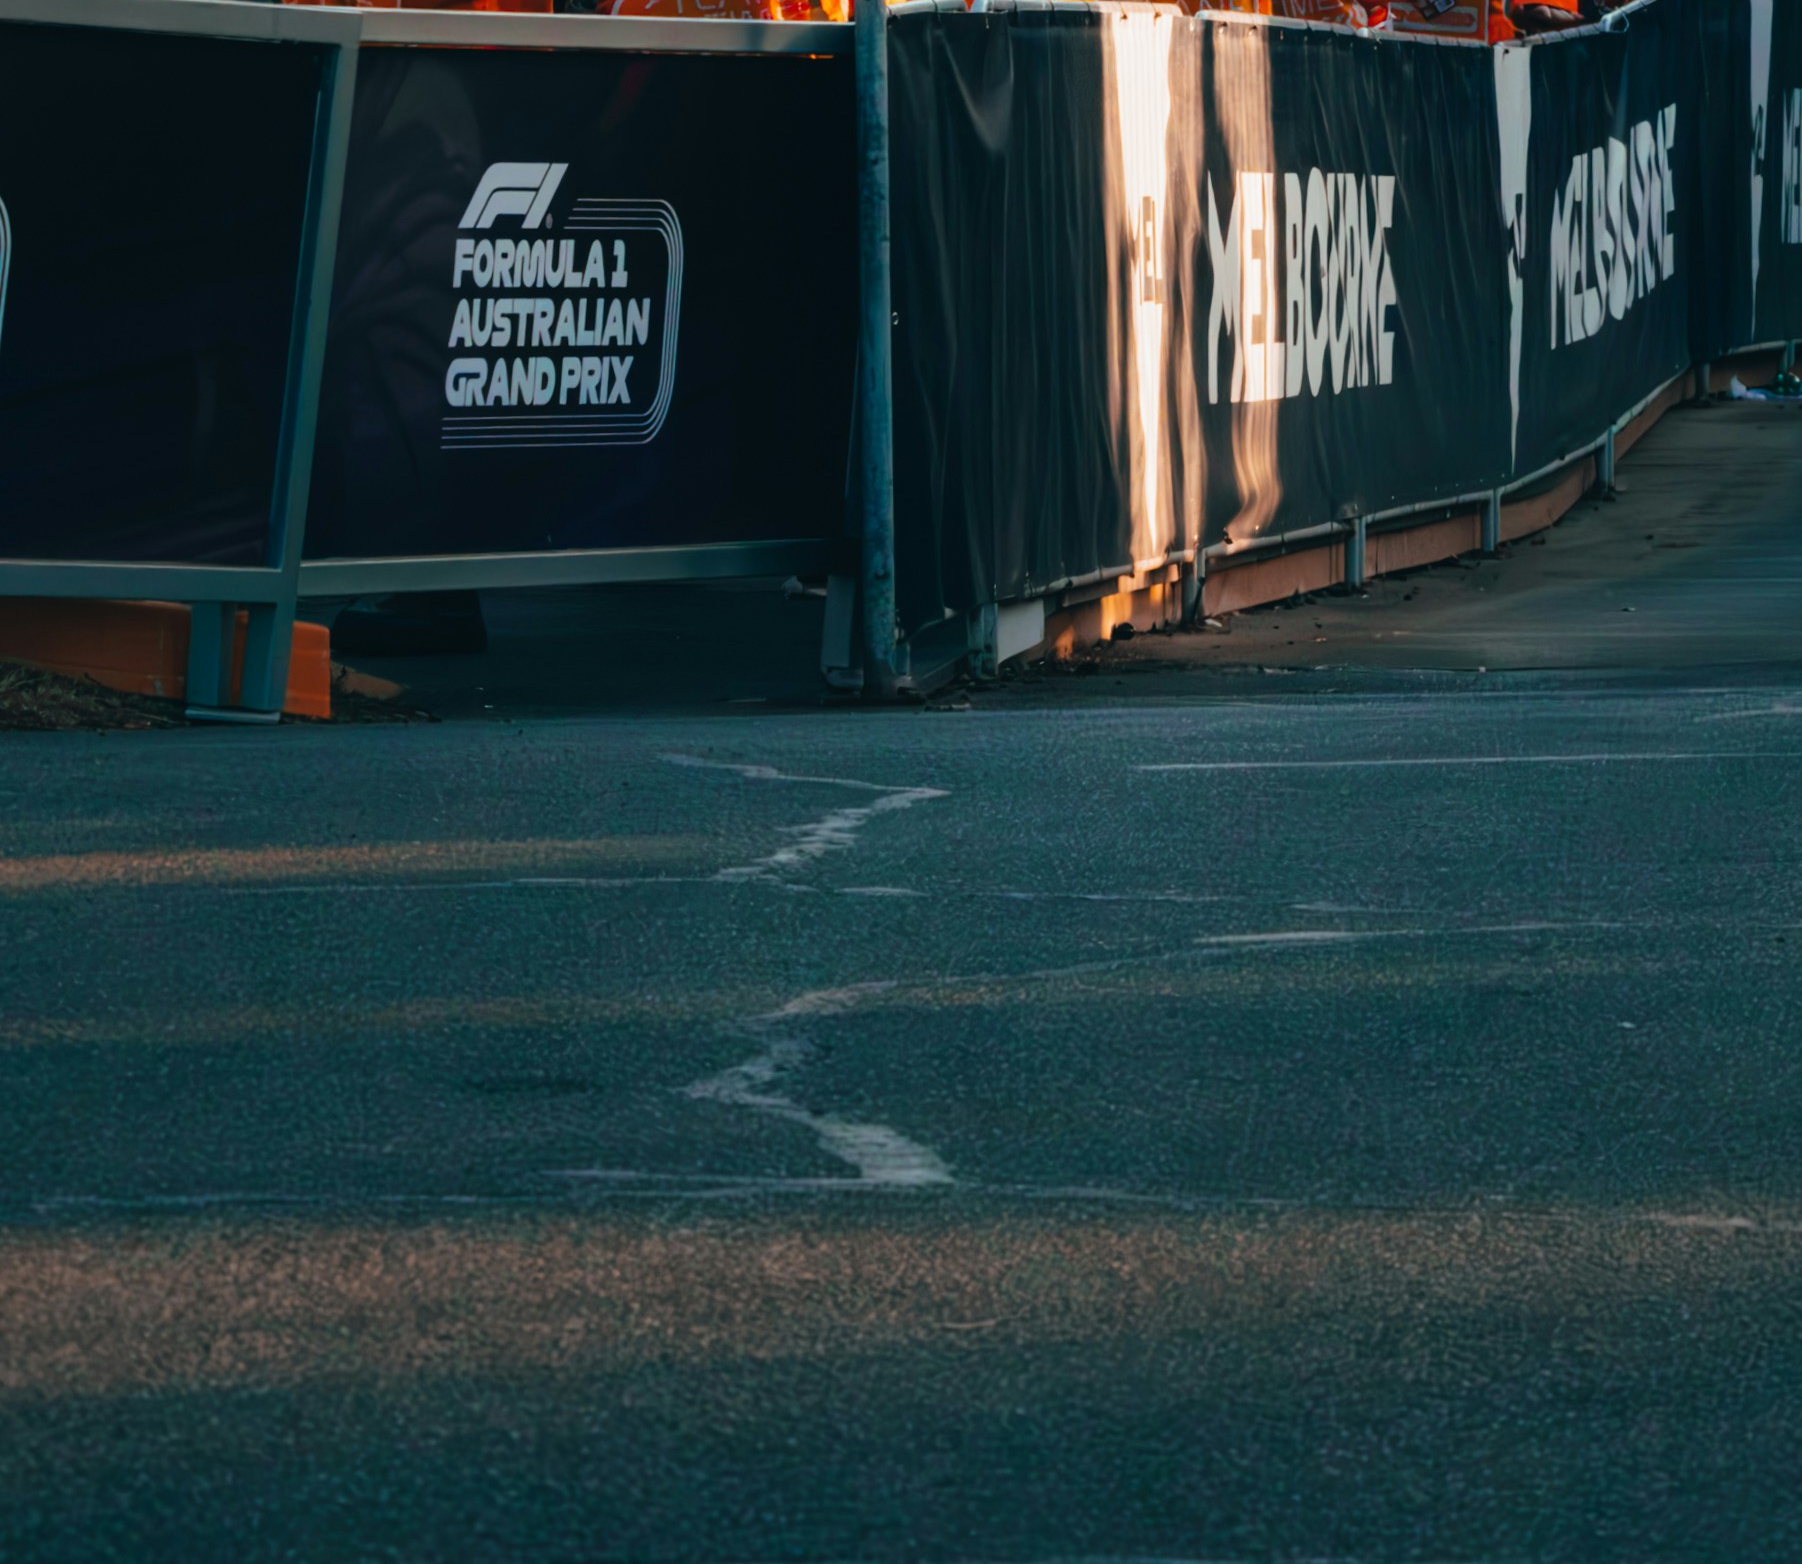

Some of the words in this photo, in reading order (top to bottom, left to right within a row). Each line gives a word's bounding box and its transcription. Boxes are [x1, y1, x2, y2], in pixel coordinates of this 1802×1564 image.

[452, 238, 606, 289] FORMULA
[611, 238, 629, 288] 1
[1207, 166, 1397, 405] MELBOURNE
[447, 297, 651, 348] AUSTRALIAN
[445, 356, 556, 407] GRAND
[559, 355, 634, 406] PRIX
